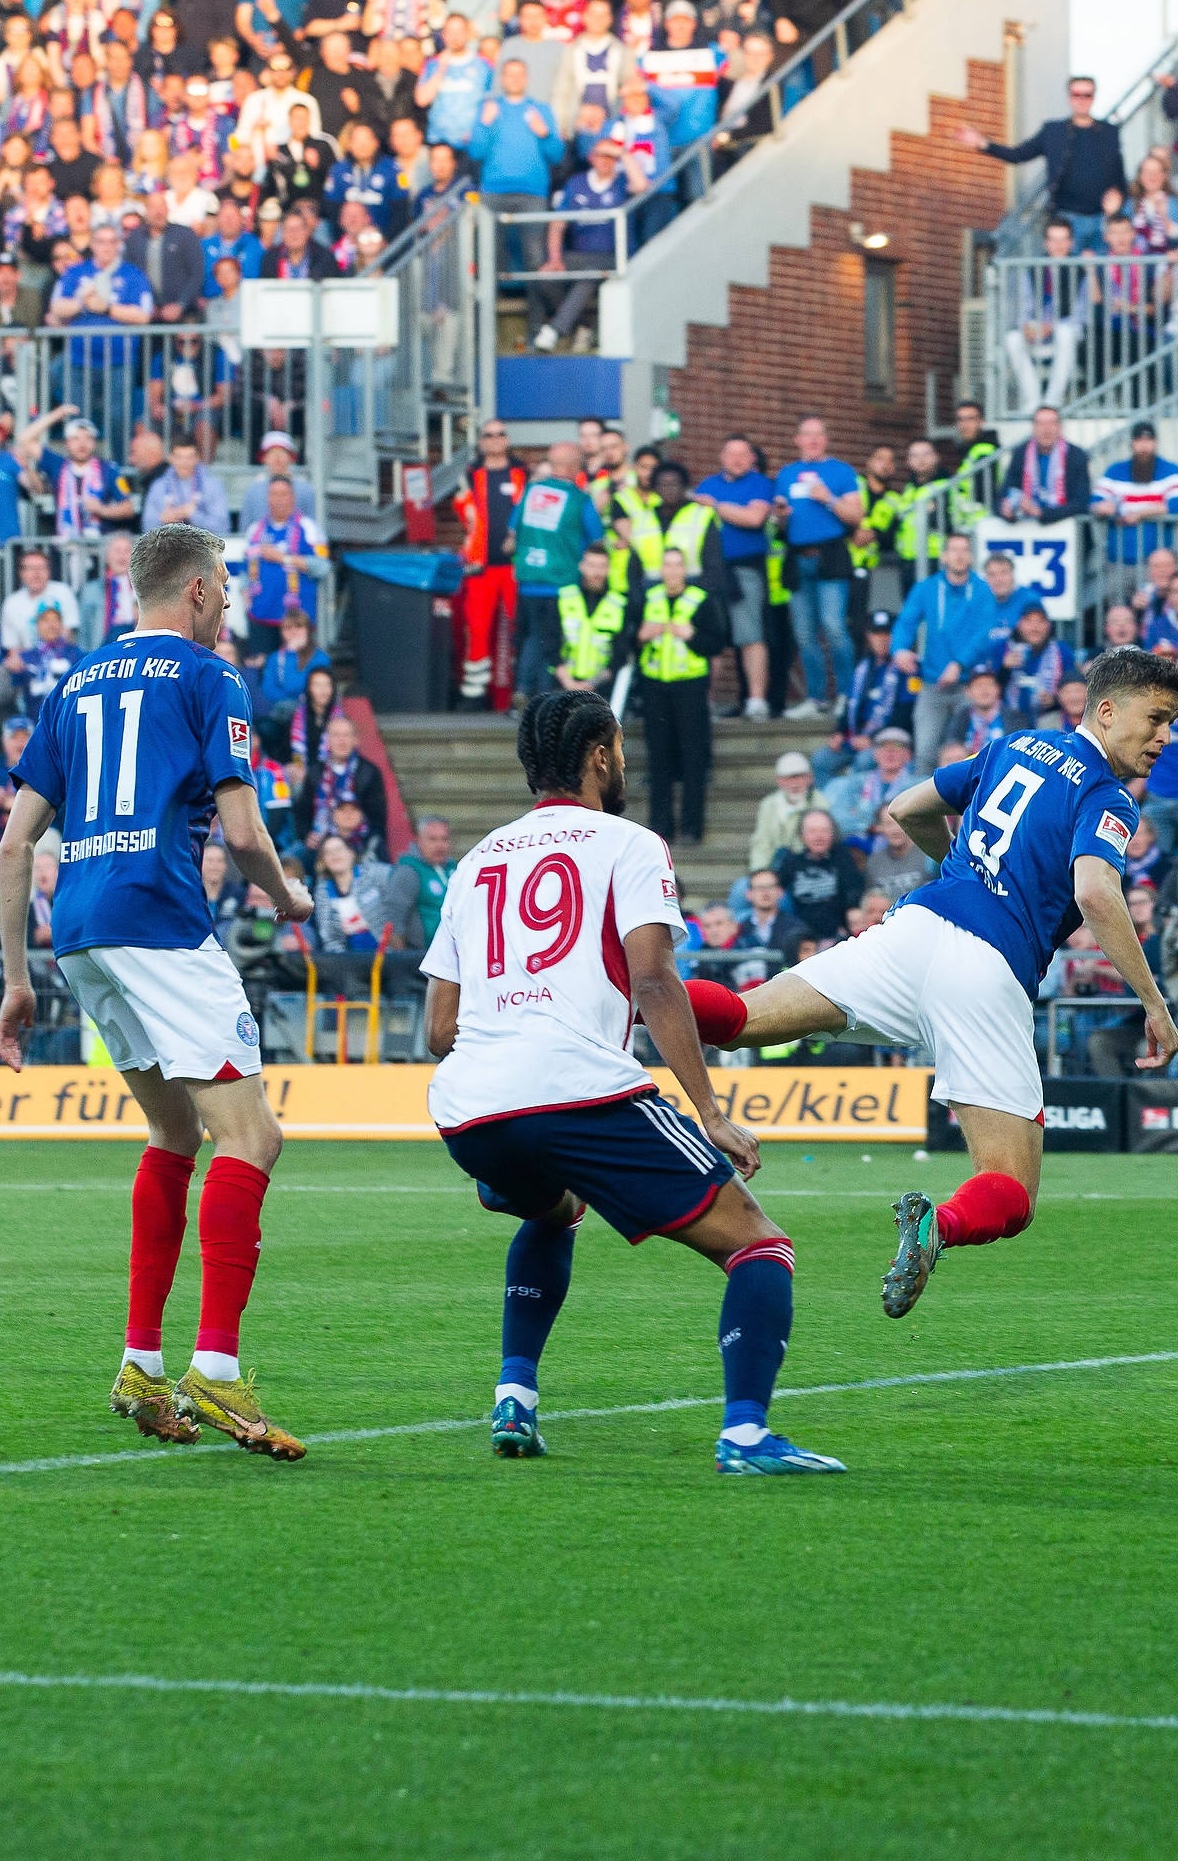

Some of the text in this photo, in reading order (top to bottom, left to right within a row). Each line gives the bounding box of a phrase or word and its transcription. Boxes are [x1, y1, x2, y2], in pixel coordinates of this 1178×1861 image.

[142, 658, 180, 679] KIEL
[77, 690, 144, 823] 11
[1057, 756, 1087, 785] KIEL
[967, 762, 1046, 878] 9
[60, 828, 156, 863] ERNHARDSSON
[476, 829, 596, 855] SSELDORF
[474, 852, 584, 980] 19
[0, 1091, 31, 1121] r
[53, 1080, 138, 1122] für
[714, 1080, 899, 1125] de/kiel
[1045, 1106, 1106, 1130] SLIGA
[506, 1285, 544, 1299] F95
